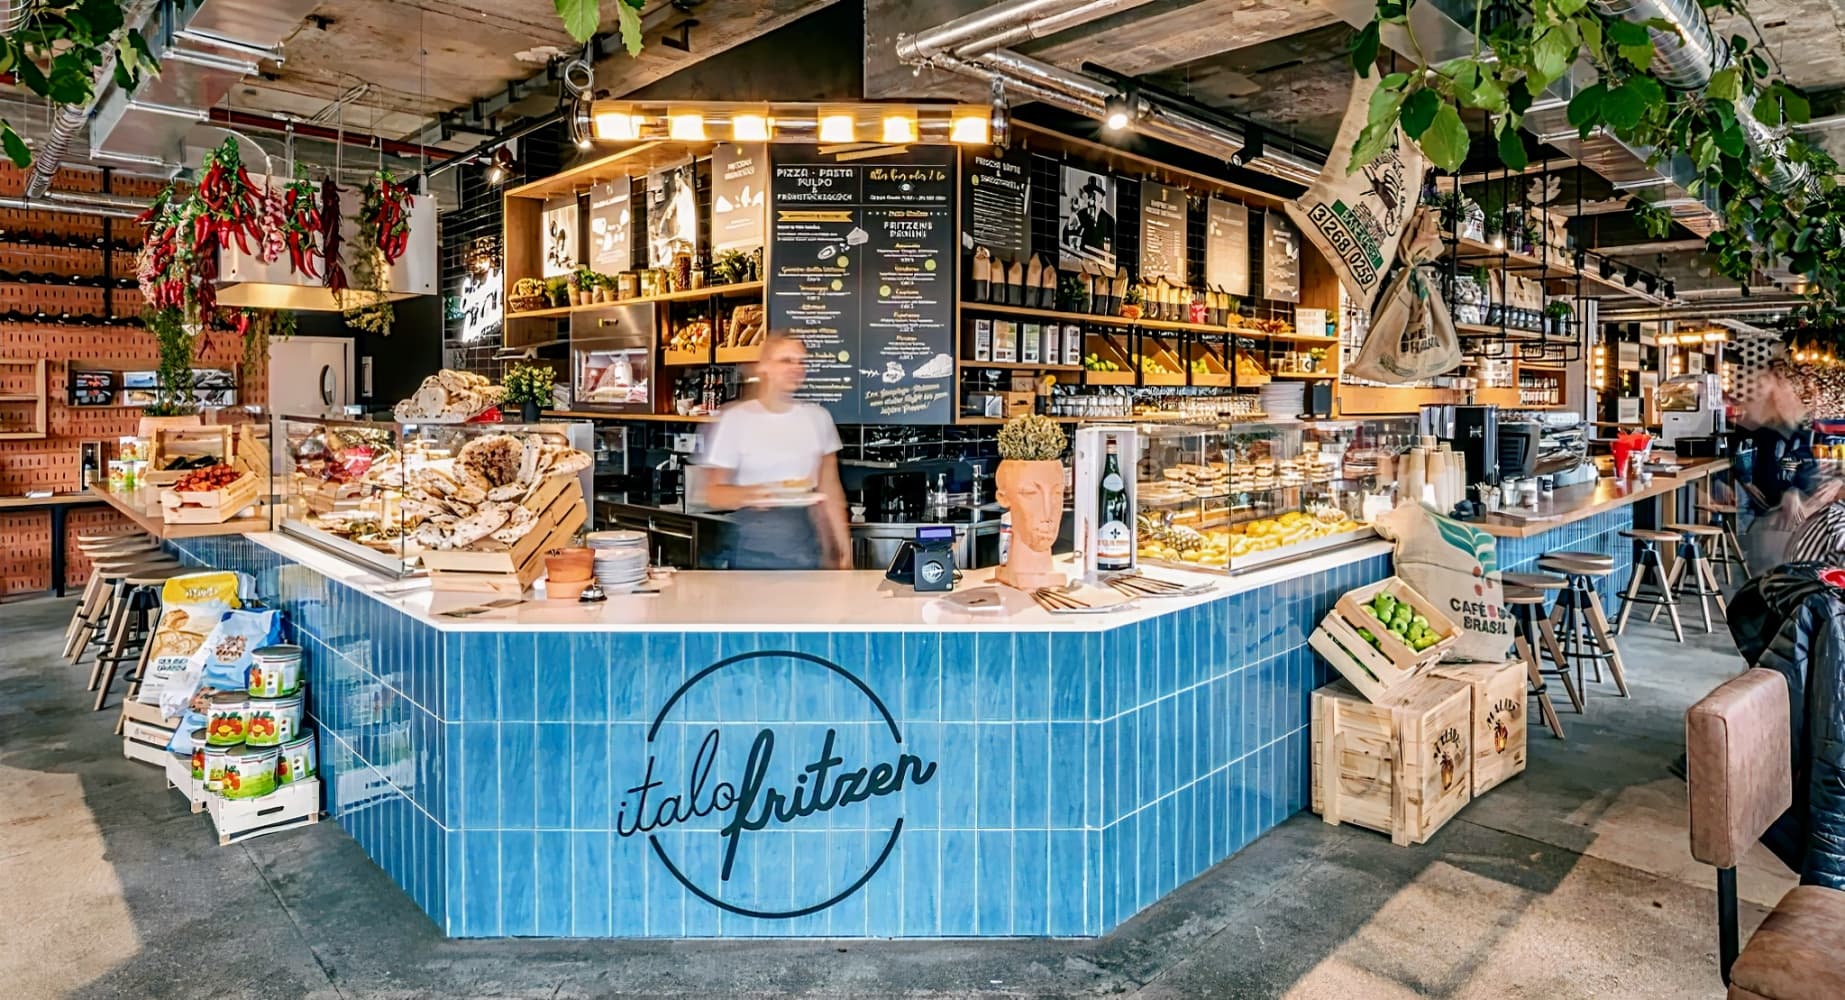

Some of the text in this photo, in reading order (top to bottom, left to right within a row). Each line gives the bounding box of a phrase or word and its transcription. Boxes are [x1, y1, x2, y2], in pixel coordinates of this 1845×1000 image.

[776, 168, 853, 178] PIZZA PASTA
[1312, 208, 1327, 221] 3
[1323, 218, 1350, 254] 268
[1349, 251, 1374, 285] 0259
[1449, 597, 1487, 618] CAFÉ
[1463, 615, 1508, 635] BRASIL
